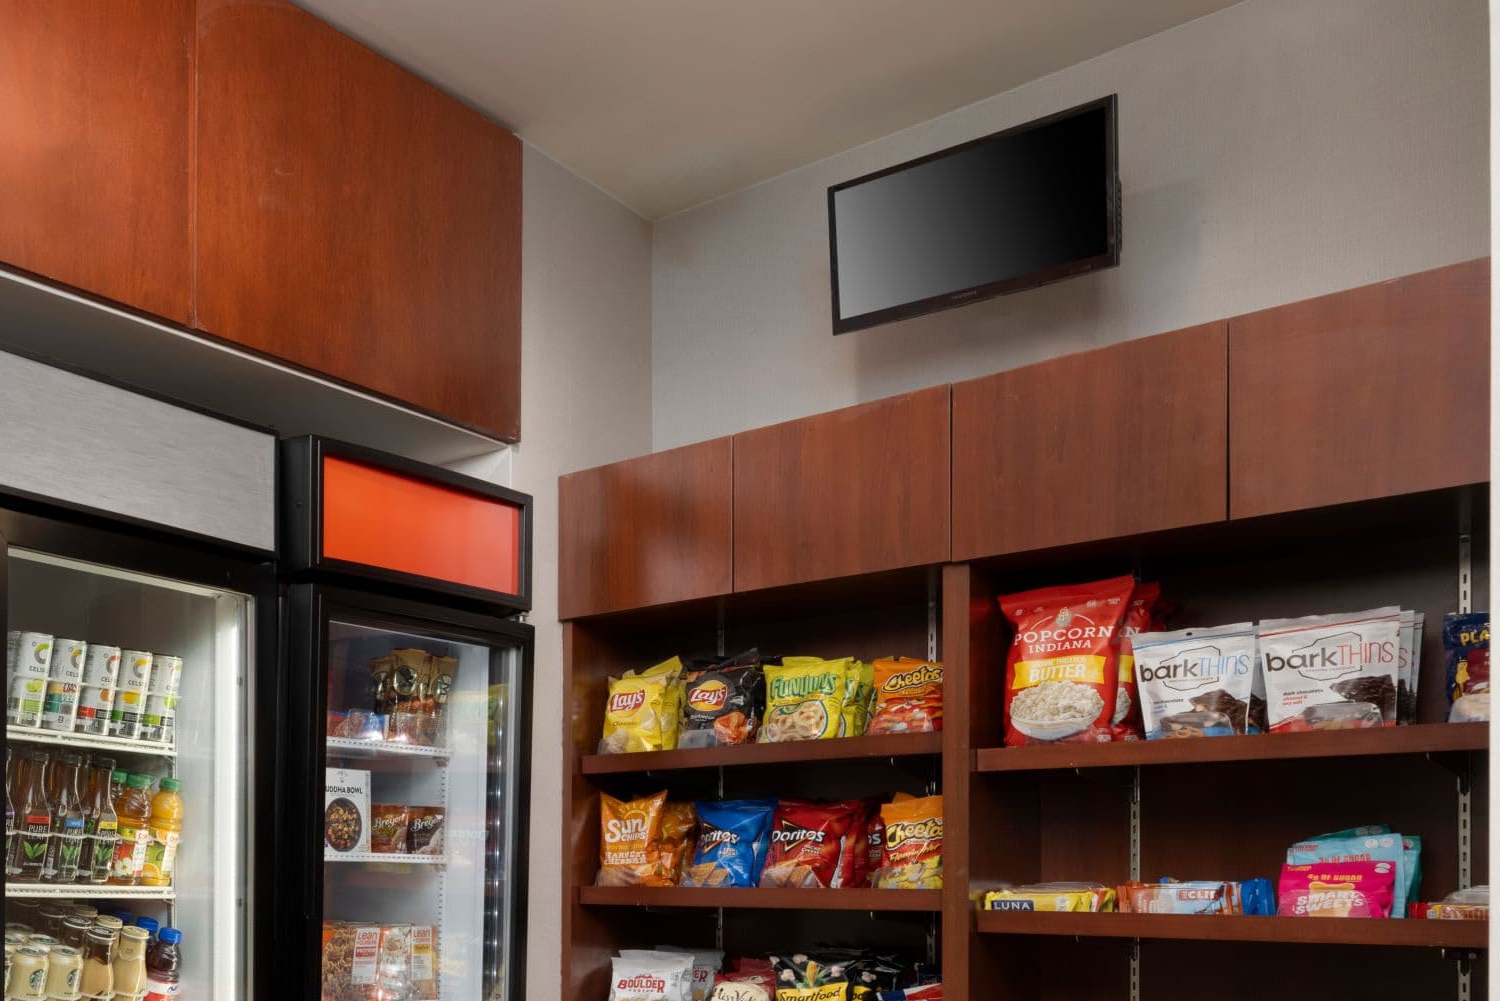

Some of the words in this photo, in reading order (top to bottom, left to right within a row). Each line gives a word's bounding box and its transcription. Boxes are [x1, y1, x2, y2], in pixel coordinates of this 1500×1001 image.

[1014, 626, 1114, 646] POPCORN
[1028, 639, 1092, 653] INDIANA
[883, 666, 943, 693] Cheetos
[1029, 664, 1087, 682] BUTTER
[346, 786, 363, 795] BOWL
[28, 823, 49, 833] PURE
[605, 818, 648, 843] Sun
[621, 831, 647, 842] CHIPS
[772, 829, 826, 843] Doritos
[994, 902, 1031, 910] LUNA
[357, 930, 377, 941] Lean
[617, 978, 666, 994] BOULDER
